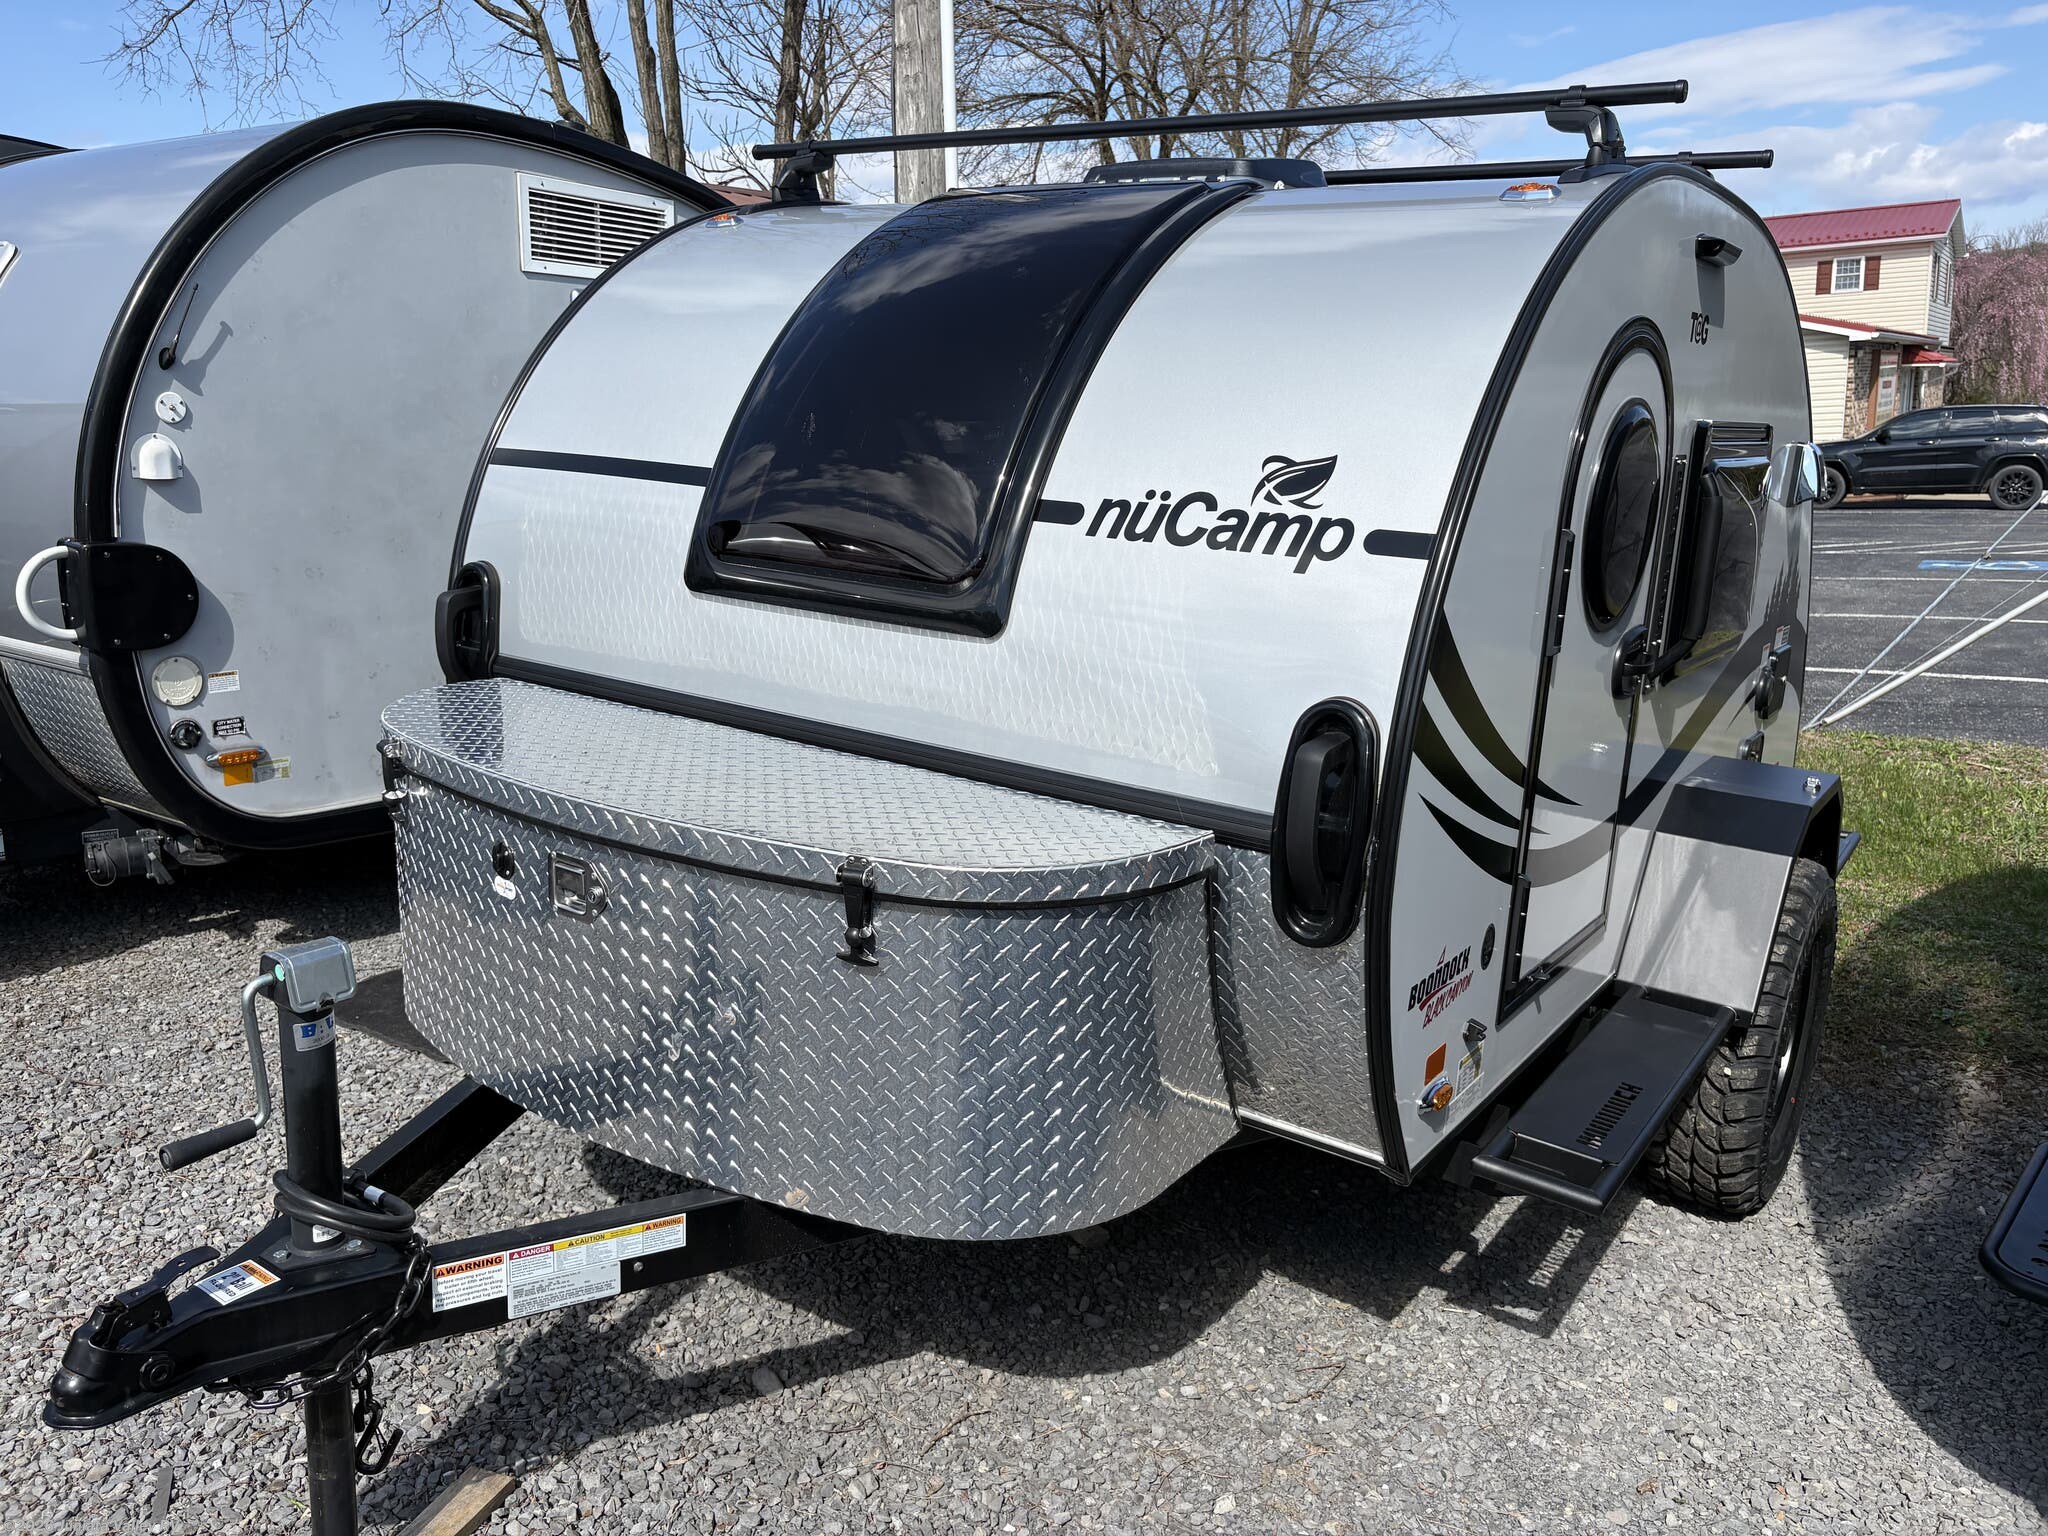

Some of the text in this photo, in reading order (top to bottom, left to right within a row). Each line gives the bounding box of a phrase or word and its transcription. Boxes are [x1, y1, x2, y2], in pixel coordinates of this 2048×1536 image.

[1690, 311, 1710, 345] T@G
[1085, 489, 1356, 574] nüCamp
[1407, 945, 1471, 1012] BOONDOCK
[652, 1217, 682, 1228] WARNING
[574, 1233, 606, 1245] CAUTION
[520, 1245, 551, 1257] DANGER
[445, 1256, 503, 1275] WARNING
[230, 1277, 254, 1291] Ball
[445, 1297, 471, 1306] pressures
